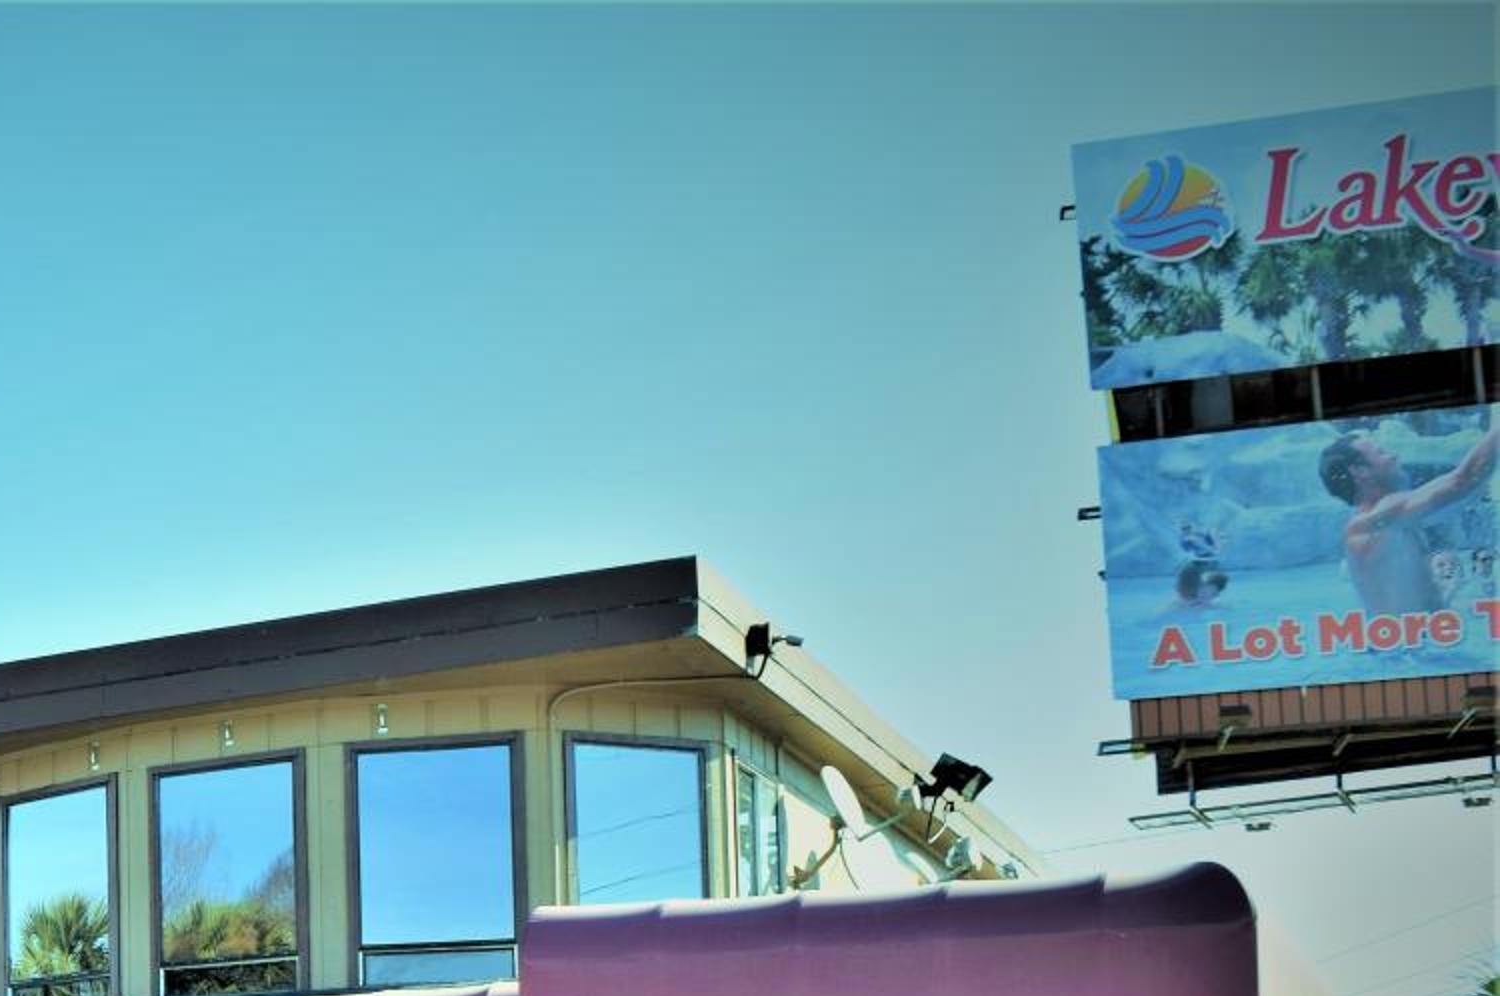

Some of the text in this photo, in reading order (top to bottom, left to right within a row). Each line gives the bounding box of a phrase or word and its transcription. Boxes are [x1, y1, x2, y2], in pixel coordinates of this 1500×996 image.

[1255, 133, 1500, 244] Lake
[1153, 627, 1195, 667] A
[1210, 618, 1303, 662] Lot
[1318, 610, 1461, 653] More
